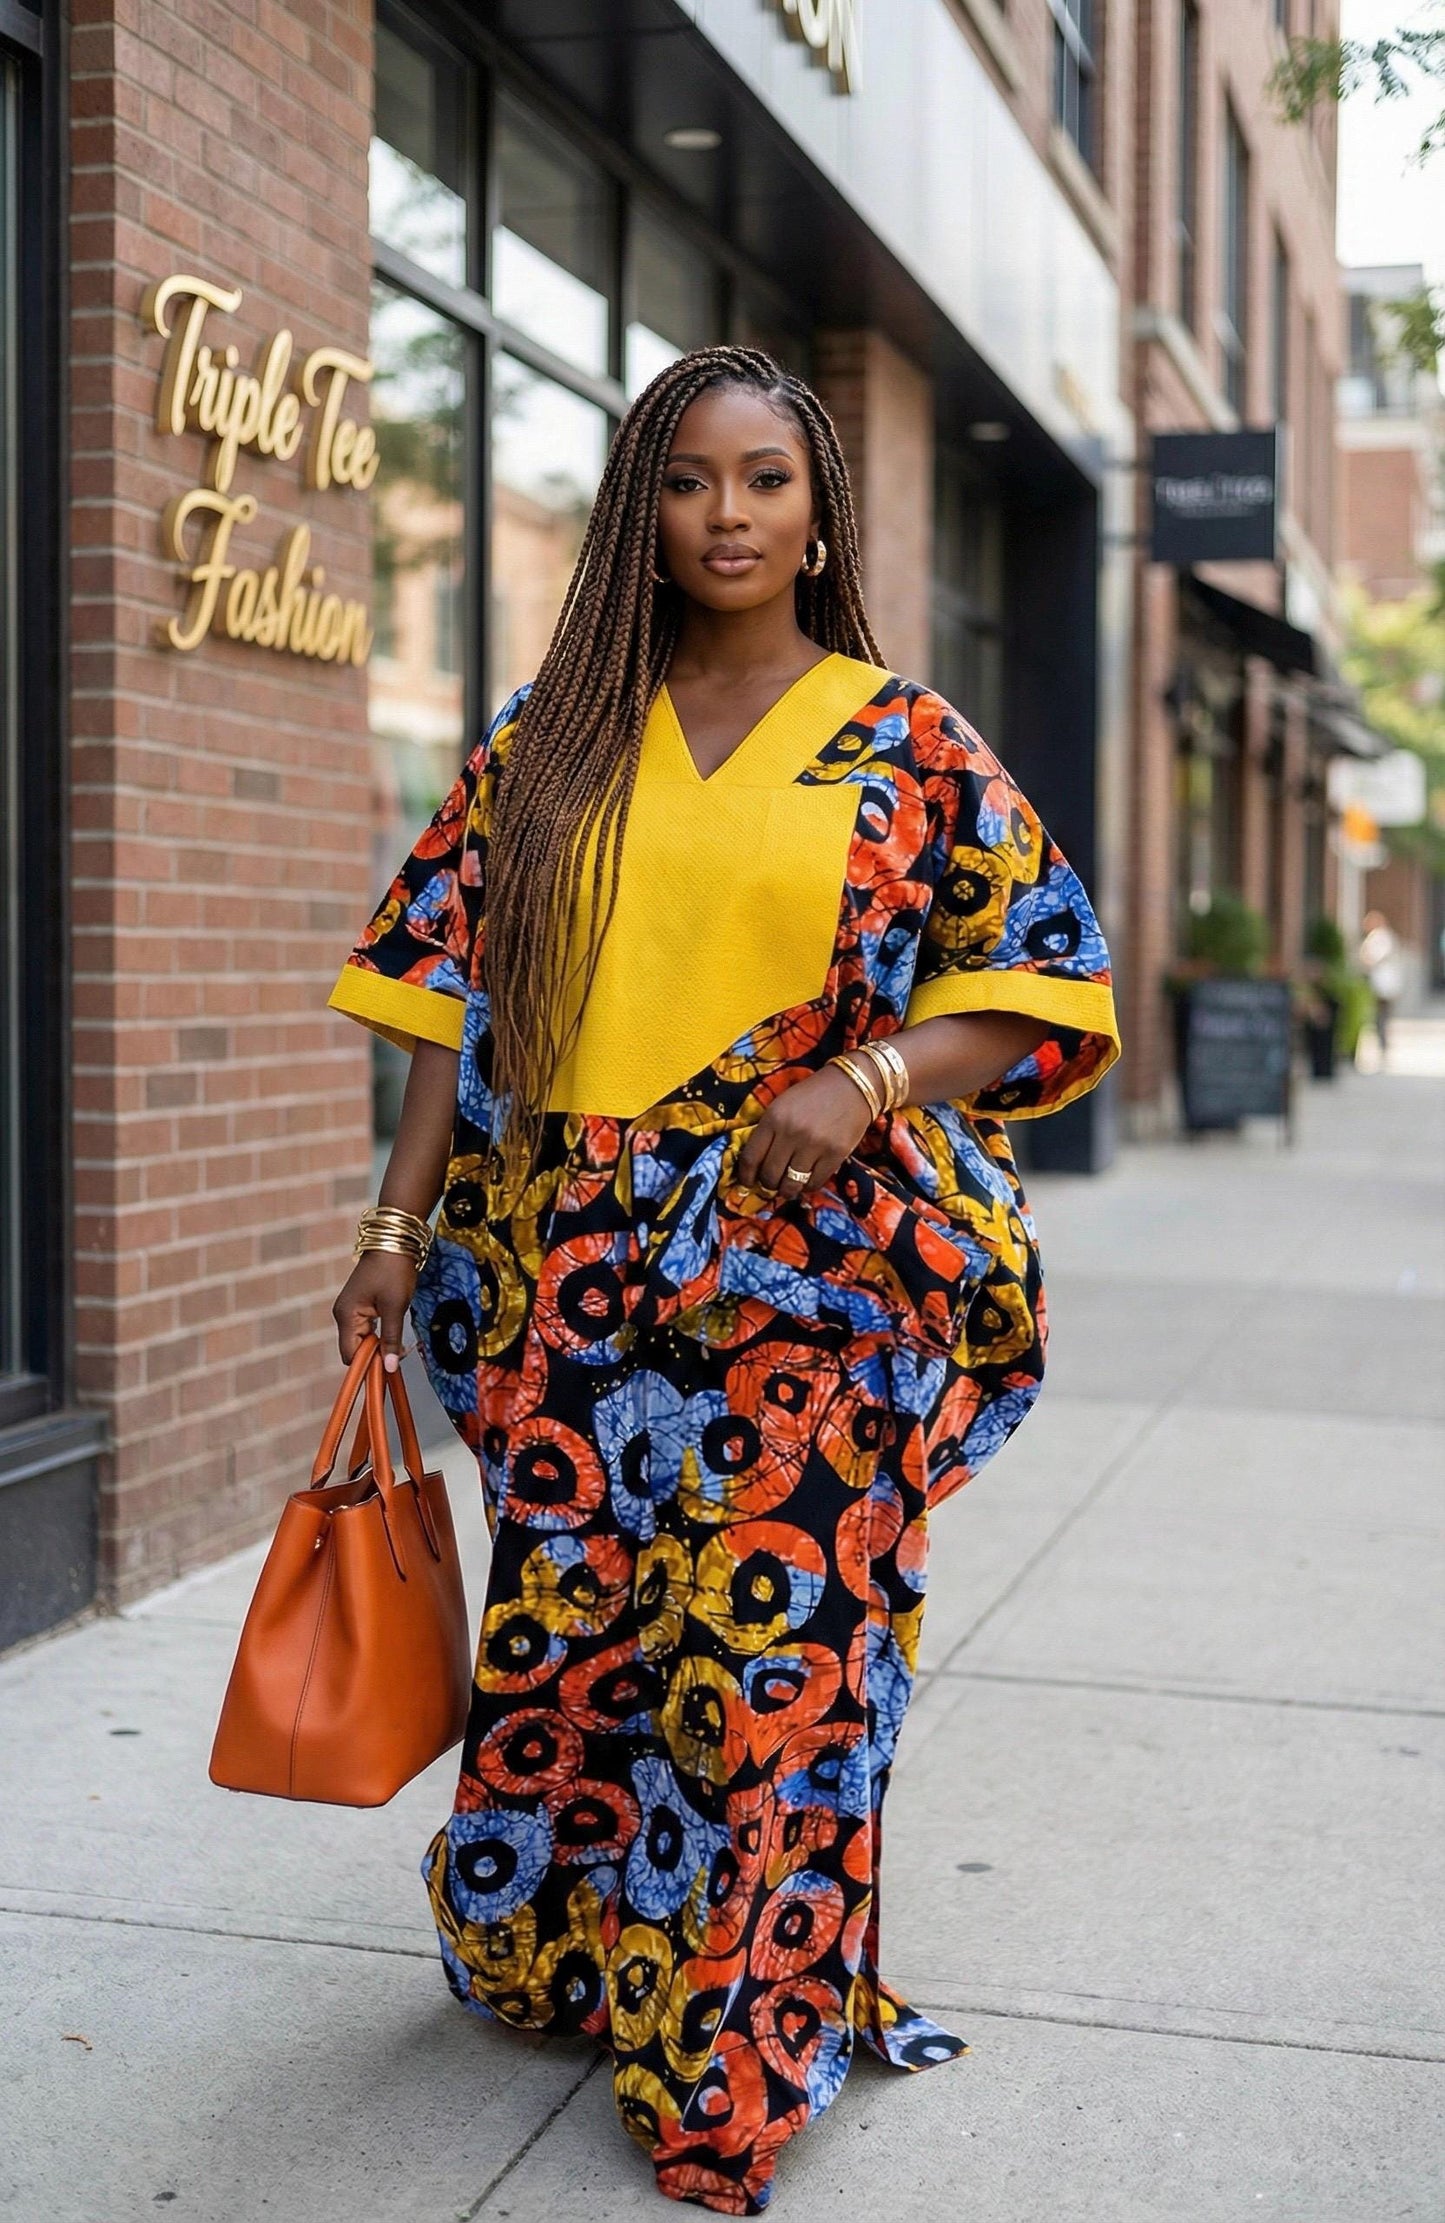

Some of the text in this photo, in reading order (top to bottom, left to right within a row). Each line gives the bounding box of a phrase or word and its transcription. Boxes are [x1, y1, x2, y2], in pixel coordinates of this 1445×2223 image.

[150, 273, 381, 494] Triple Tee
[167, 488, 374, 668] Fashion
